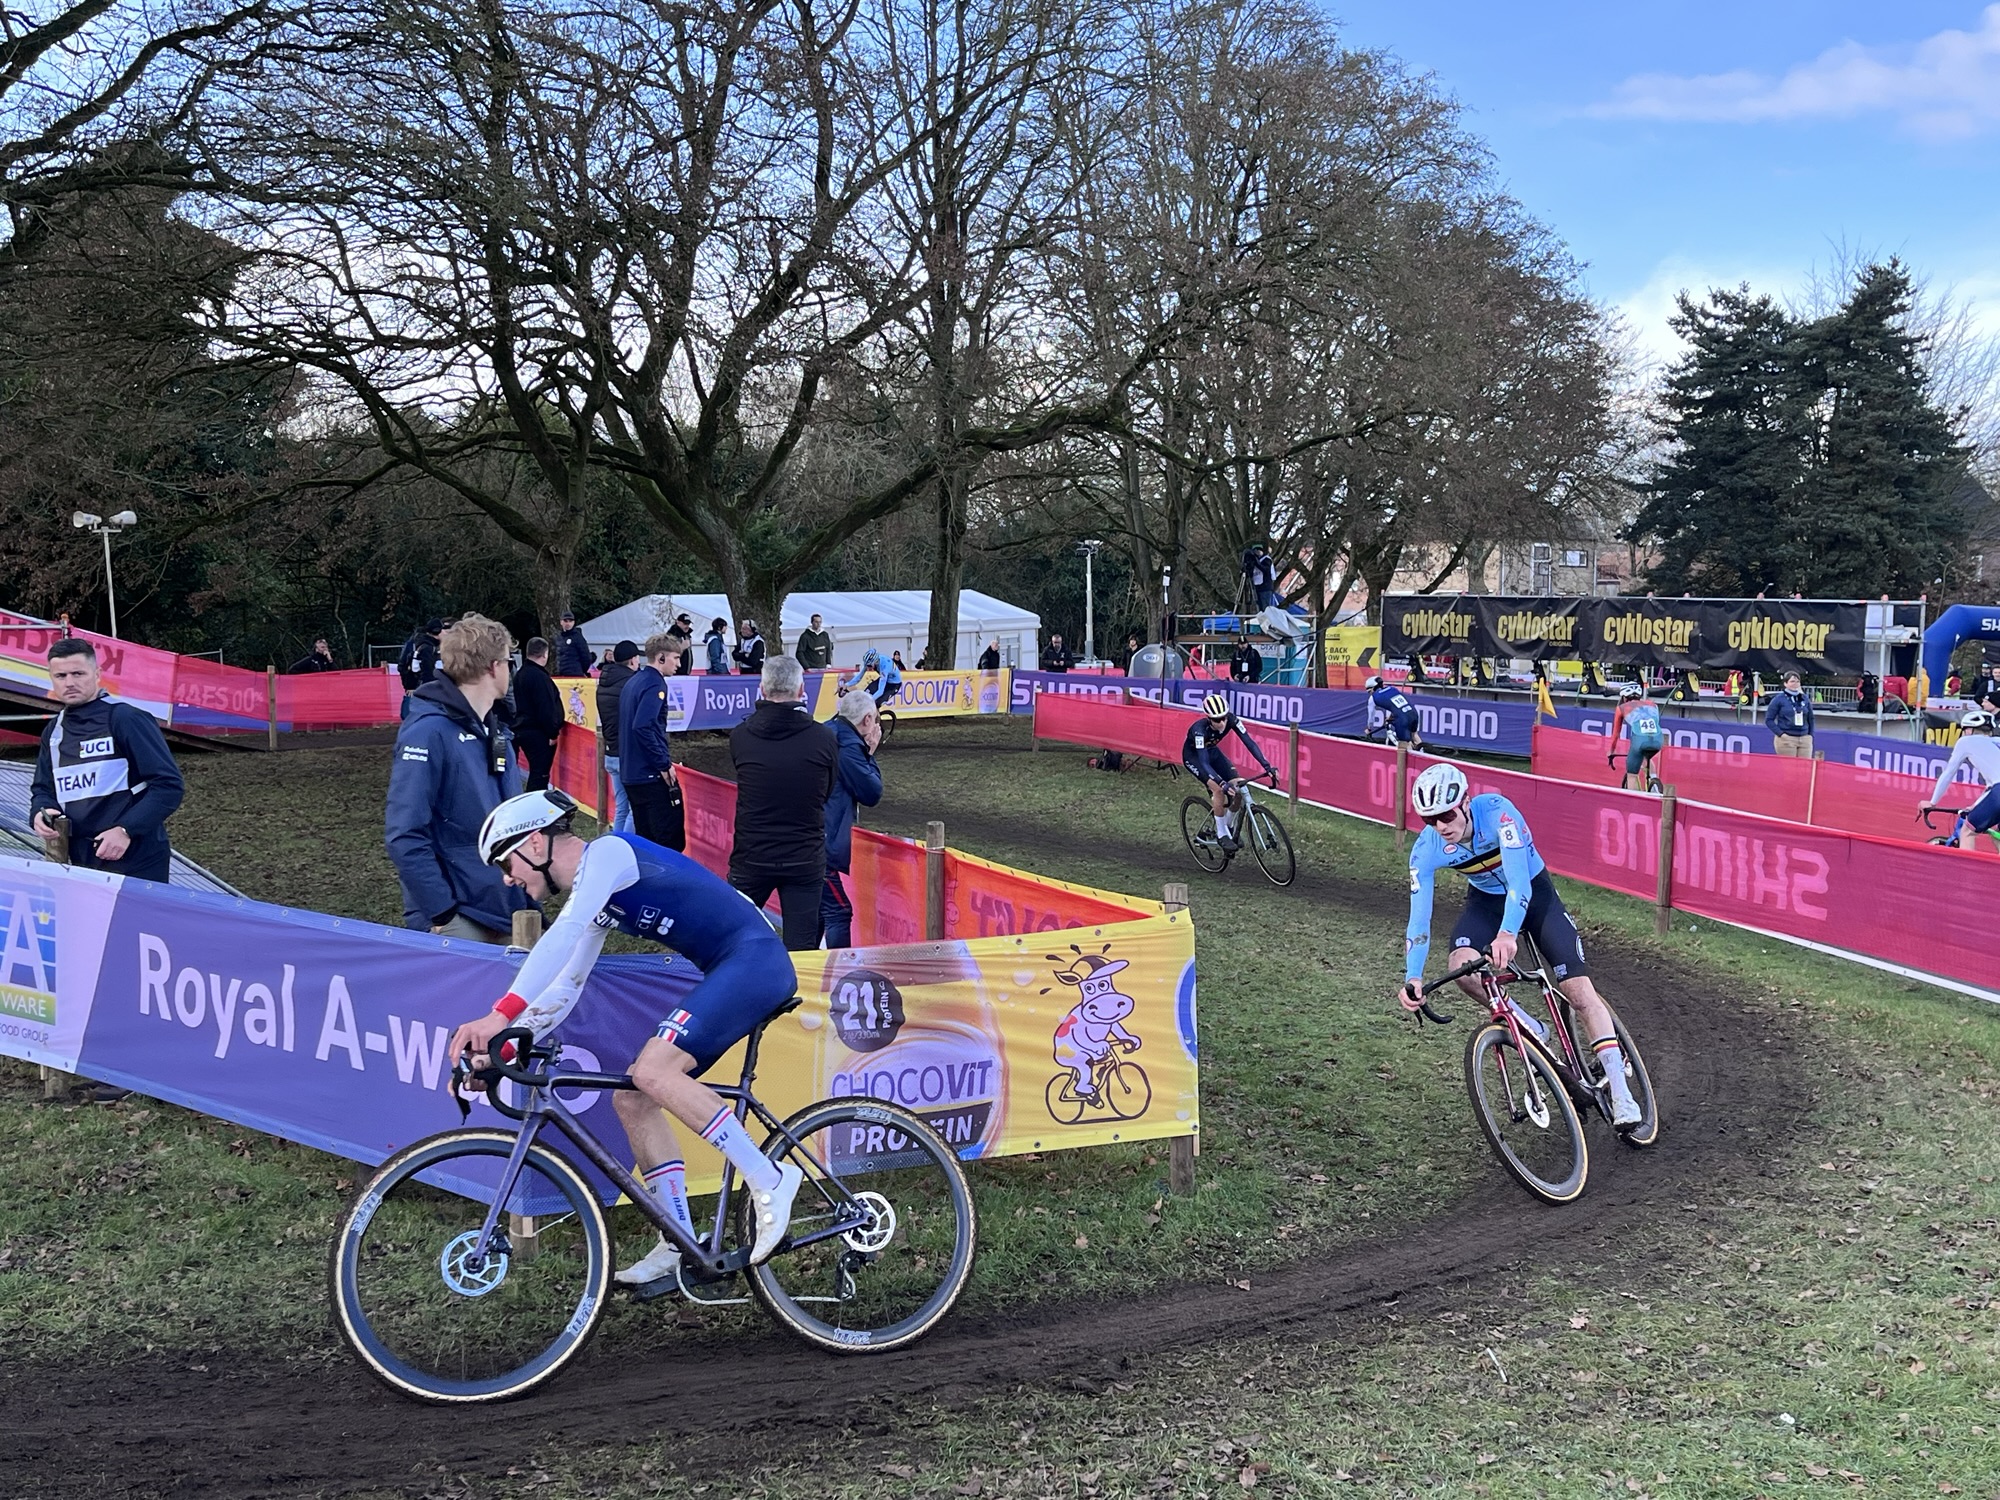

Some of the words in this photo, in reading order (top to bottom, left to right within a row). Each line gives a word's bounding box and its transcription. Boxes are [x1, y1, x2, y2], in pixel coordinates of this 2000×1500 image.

[1402, 609, 1473, 639] cyklostar
[1498, 611, 1575, 642] cyklostar
[1604, 613, 1694, 646] cyklostar
[1728, 617, 1830, 652] cyklostar
[1664, 646, 1689, 654] ORIGINAL
[1796, 651, 1825, 660] ORIGINAL
[705, 688, 752, 715] Royal
[1641, 720, 1656, 731] 48
[85, 741, 110, 754] UCI
[57, 772, 96, 793] TEAM
[495, 816, 548, 839] S-WORKS
[1505, 829, 1514, 841] 8
[839, 981, 878, 1031] 21
[21, 1028, 49, 1044] GROUP
[138, 932, 296, 1059] Royal
[315, 975, 603, 1116] A-we
[849, 1114, 973, 1154] PROIN
